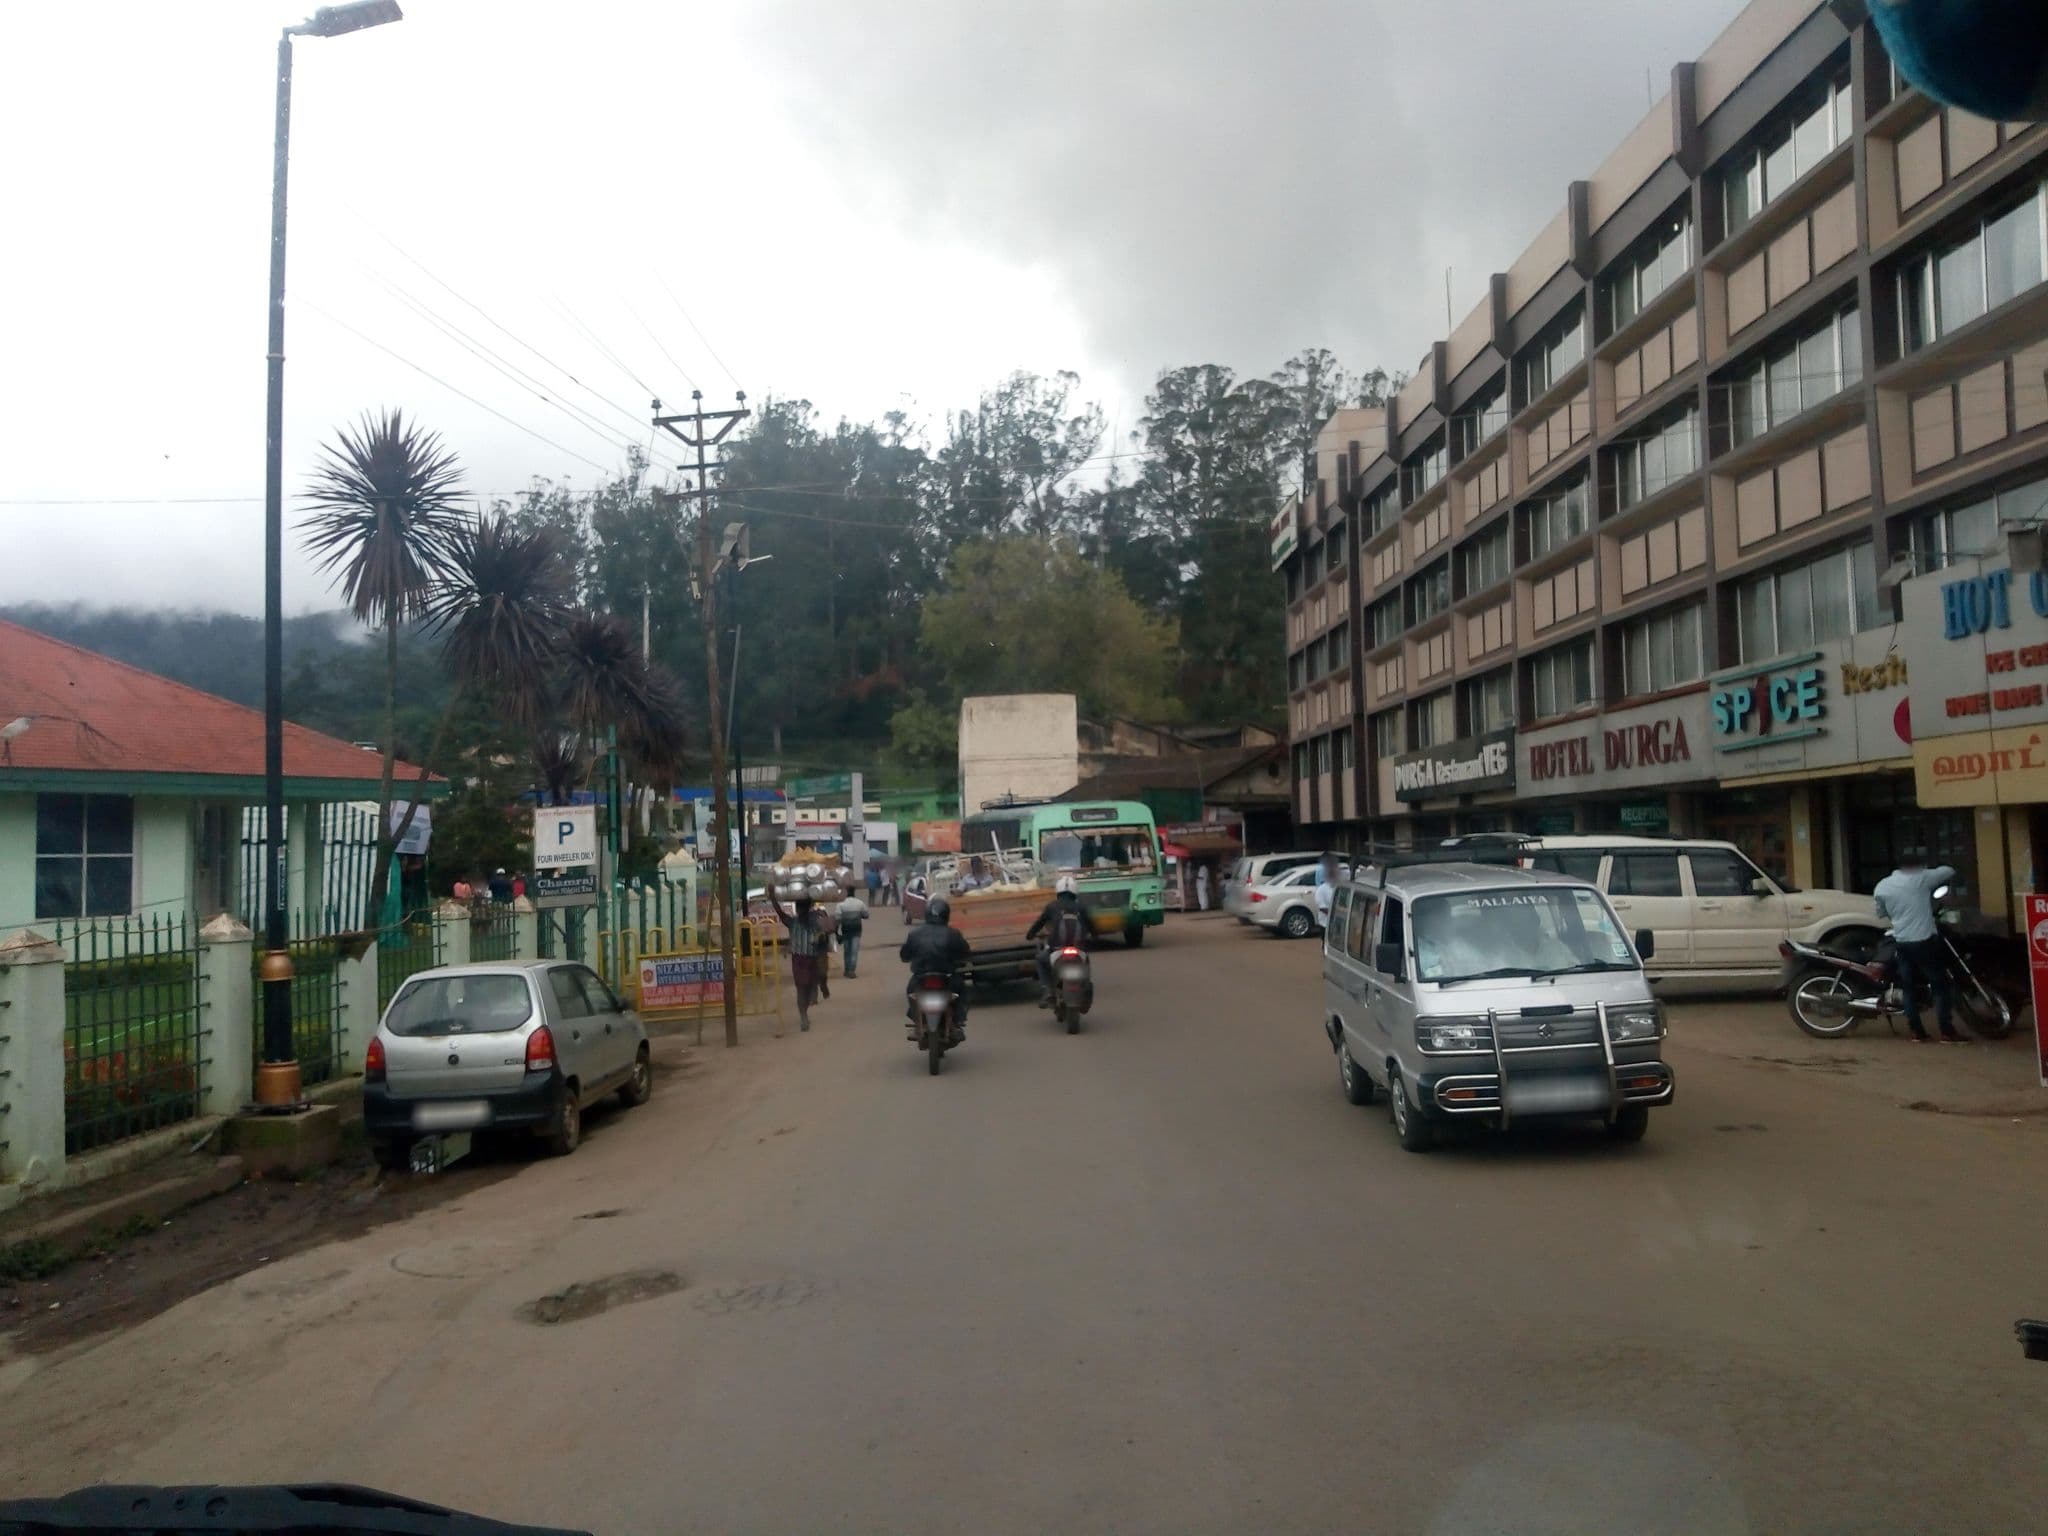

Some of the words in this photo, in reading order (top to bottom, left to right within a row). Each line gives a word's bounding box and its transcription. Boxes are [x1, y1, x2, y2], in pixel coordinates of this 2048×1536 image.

[1941, 567, 2013, 641] HOT
[1394, 758, 1435, 792] DURGA
[1483, 741, 1508, 776] VEG
[1530, 736, 1595, 781] HOTEL
[1604, 717, 1692, 770] DURGA
[559, 821, 575, 845] P
[537, 854, 552, 863] FOUR
[554, 852, 580, 863] WHEELER
[537, 876, 594, 888] Chamraj
